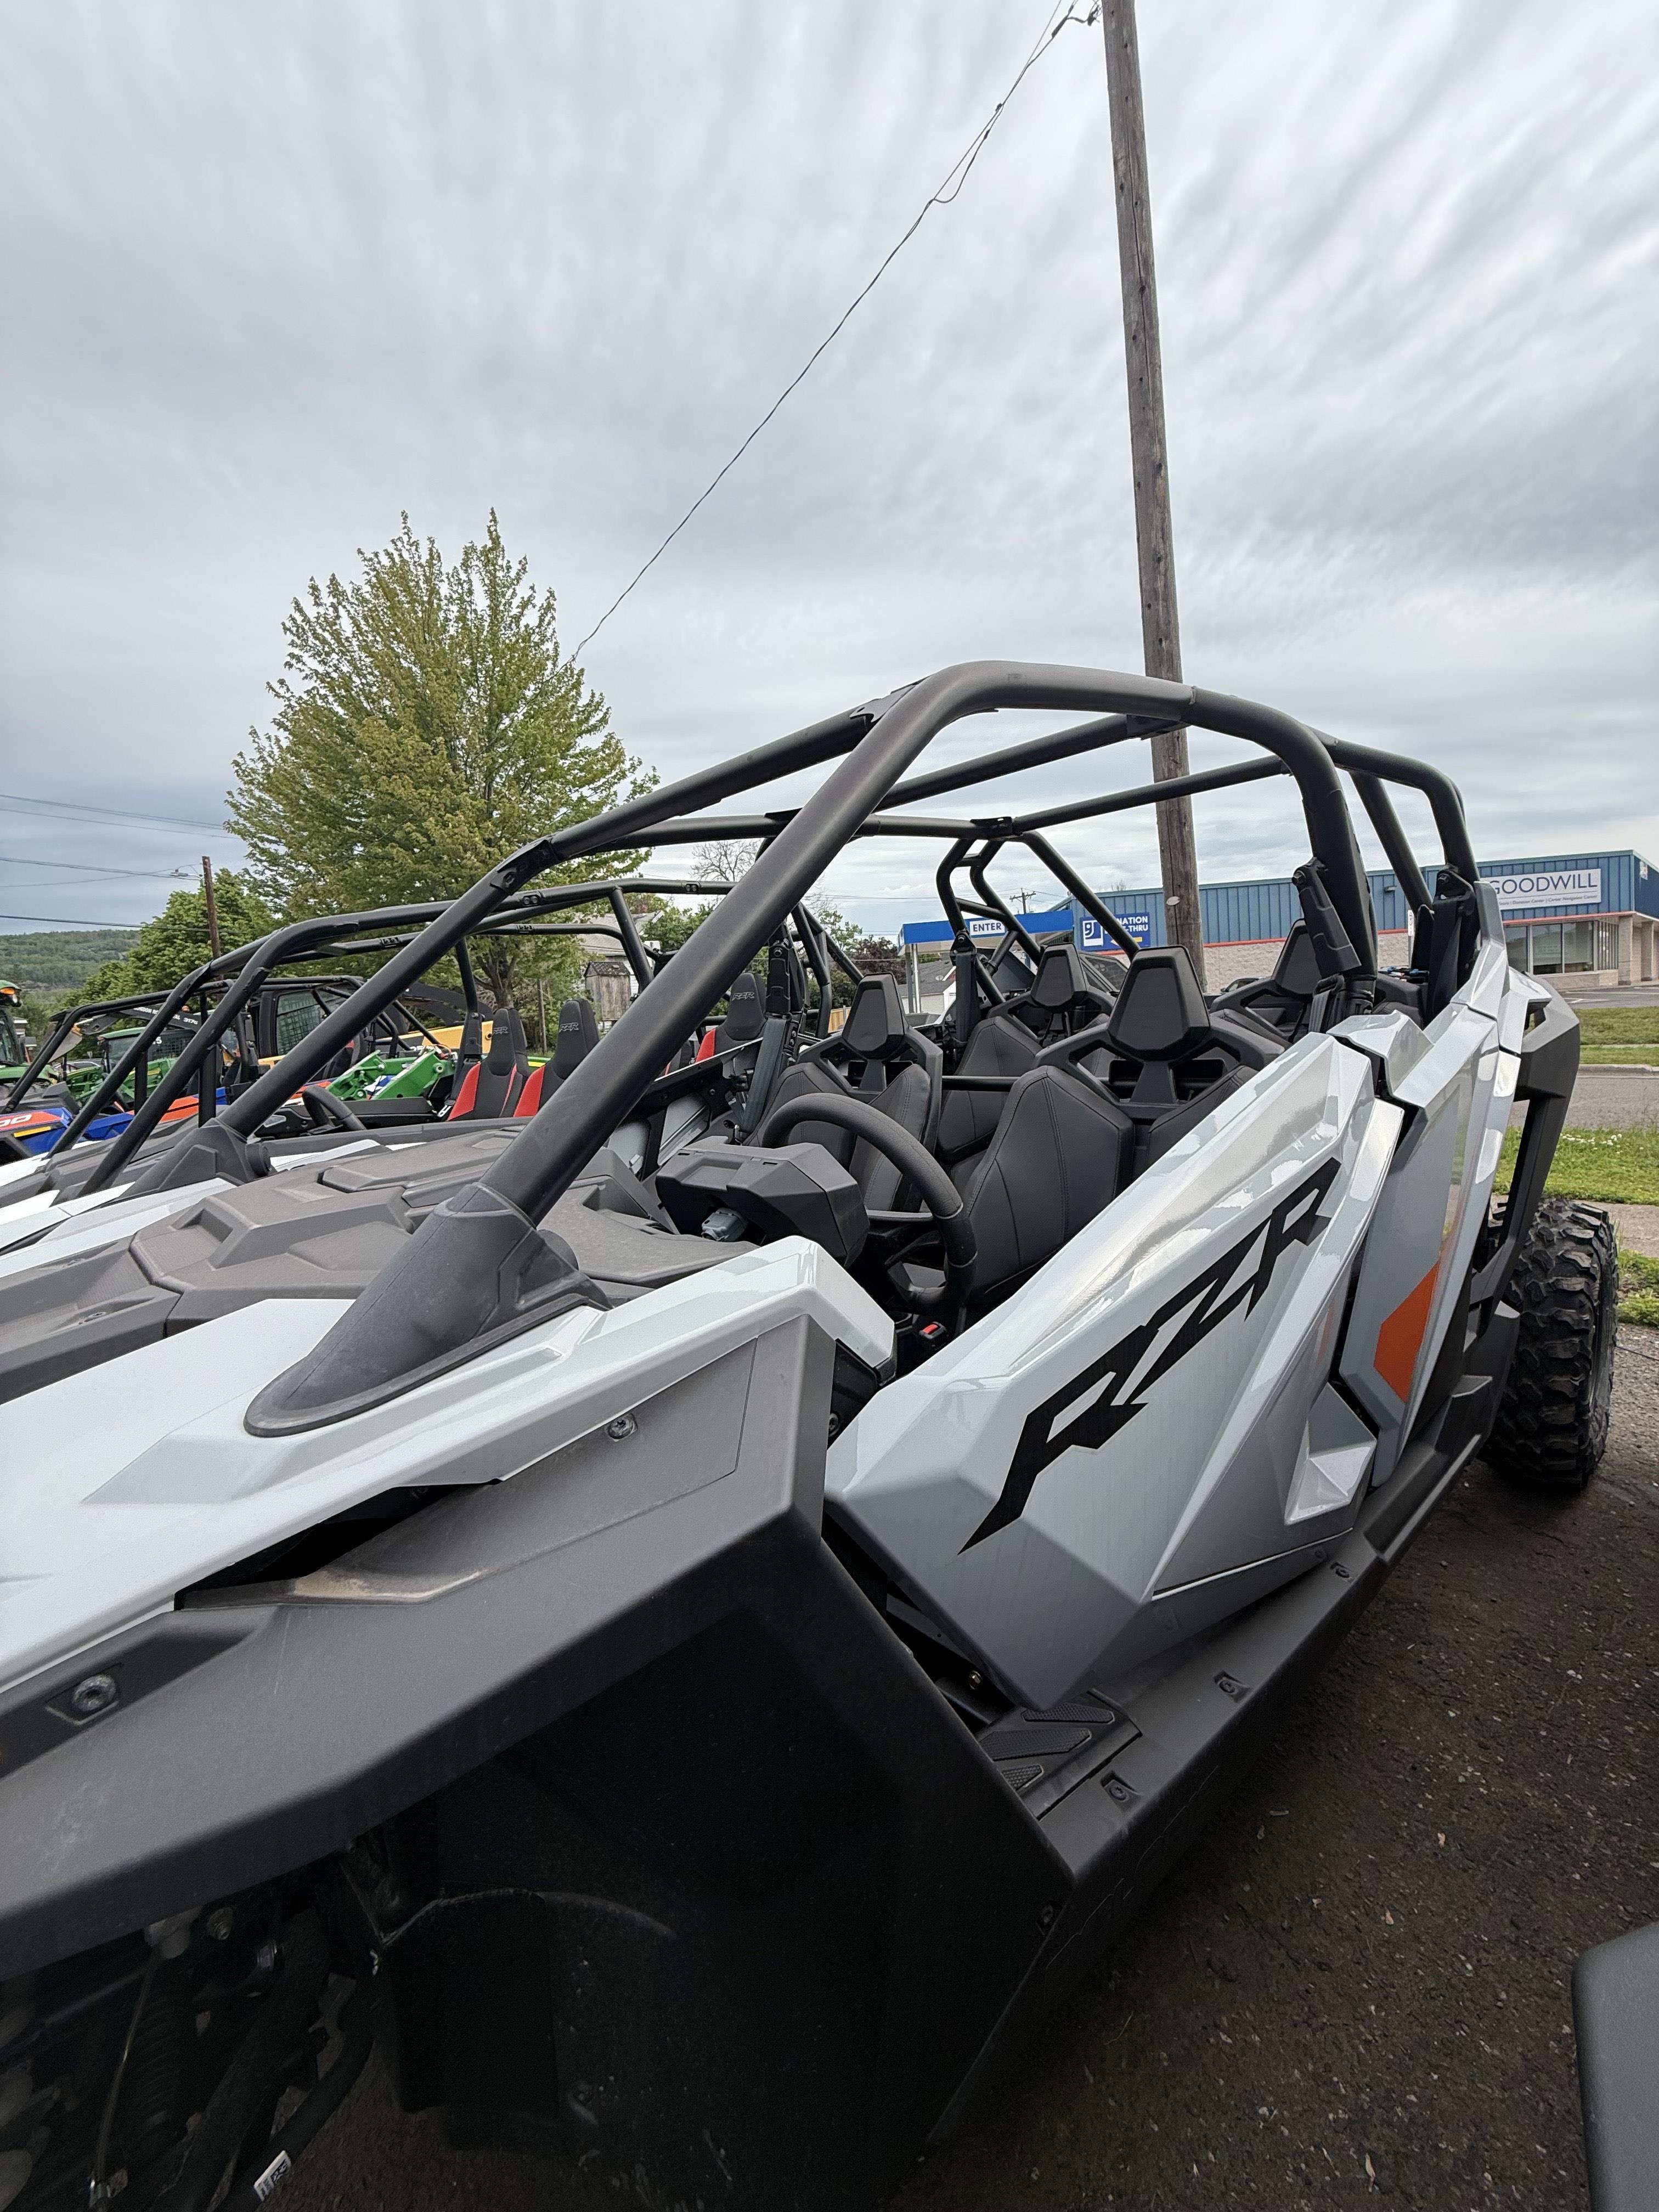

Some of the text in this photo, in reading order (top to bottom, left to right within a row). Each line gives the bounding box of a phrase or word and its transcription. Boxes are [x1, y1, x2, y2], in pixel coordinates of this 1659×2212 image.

[1489, 873, 1598, 894] GOODWILL
[973, 922, 1002, 932] ENTER
[1116, 916, 1148, 925] NATION
[957, 1156, 1342, 1556] RZR
